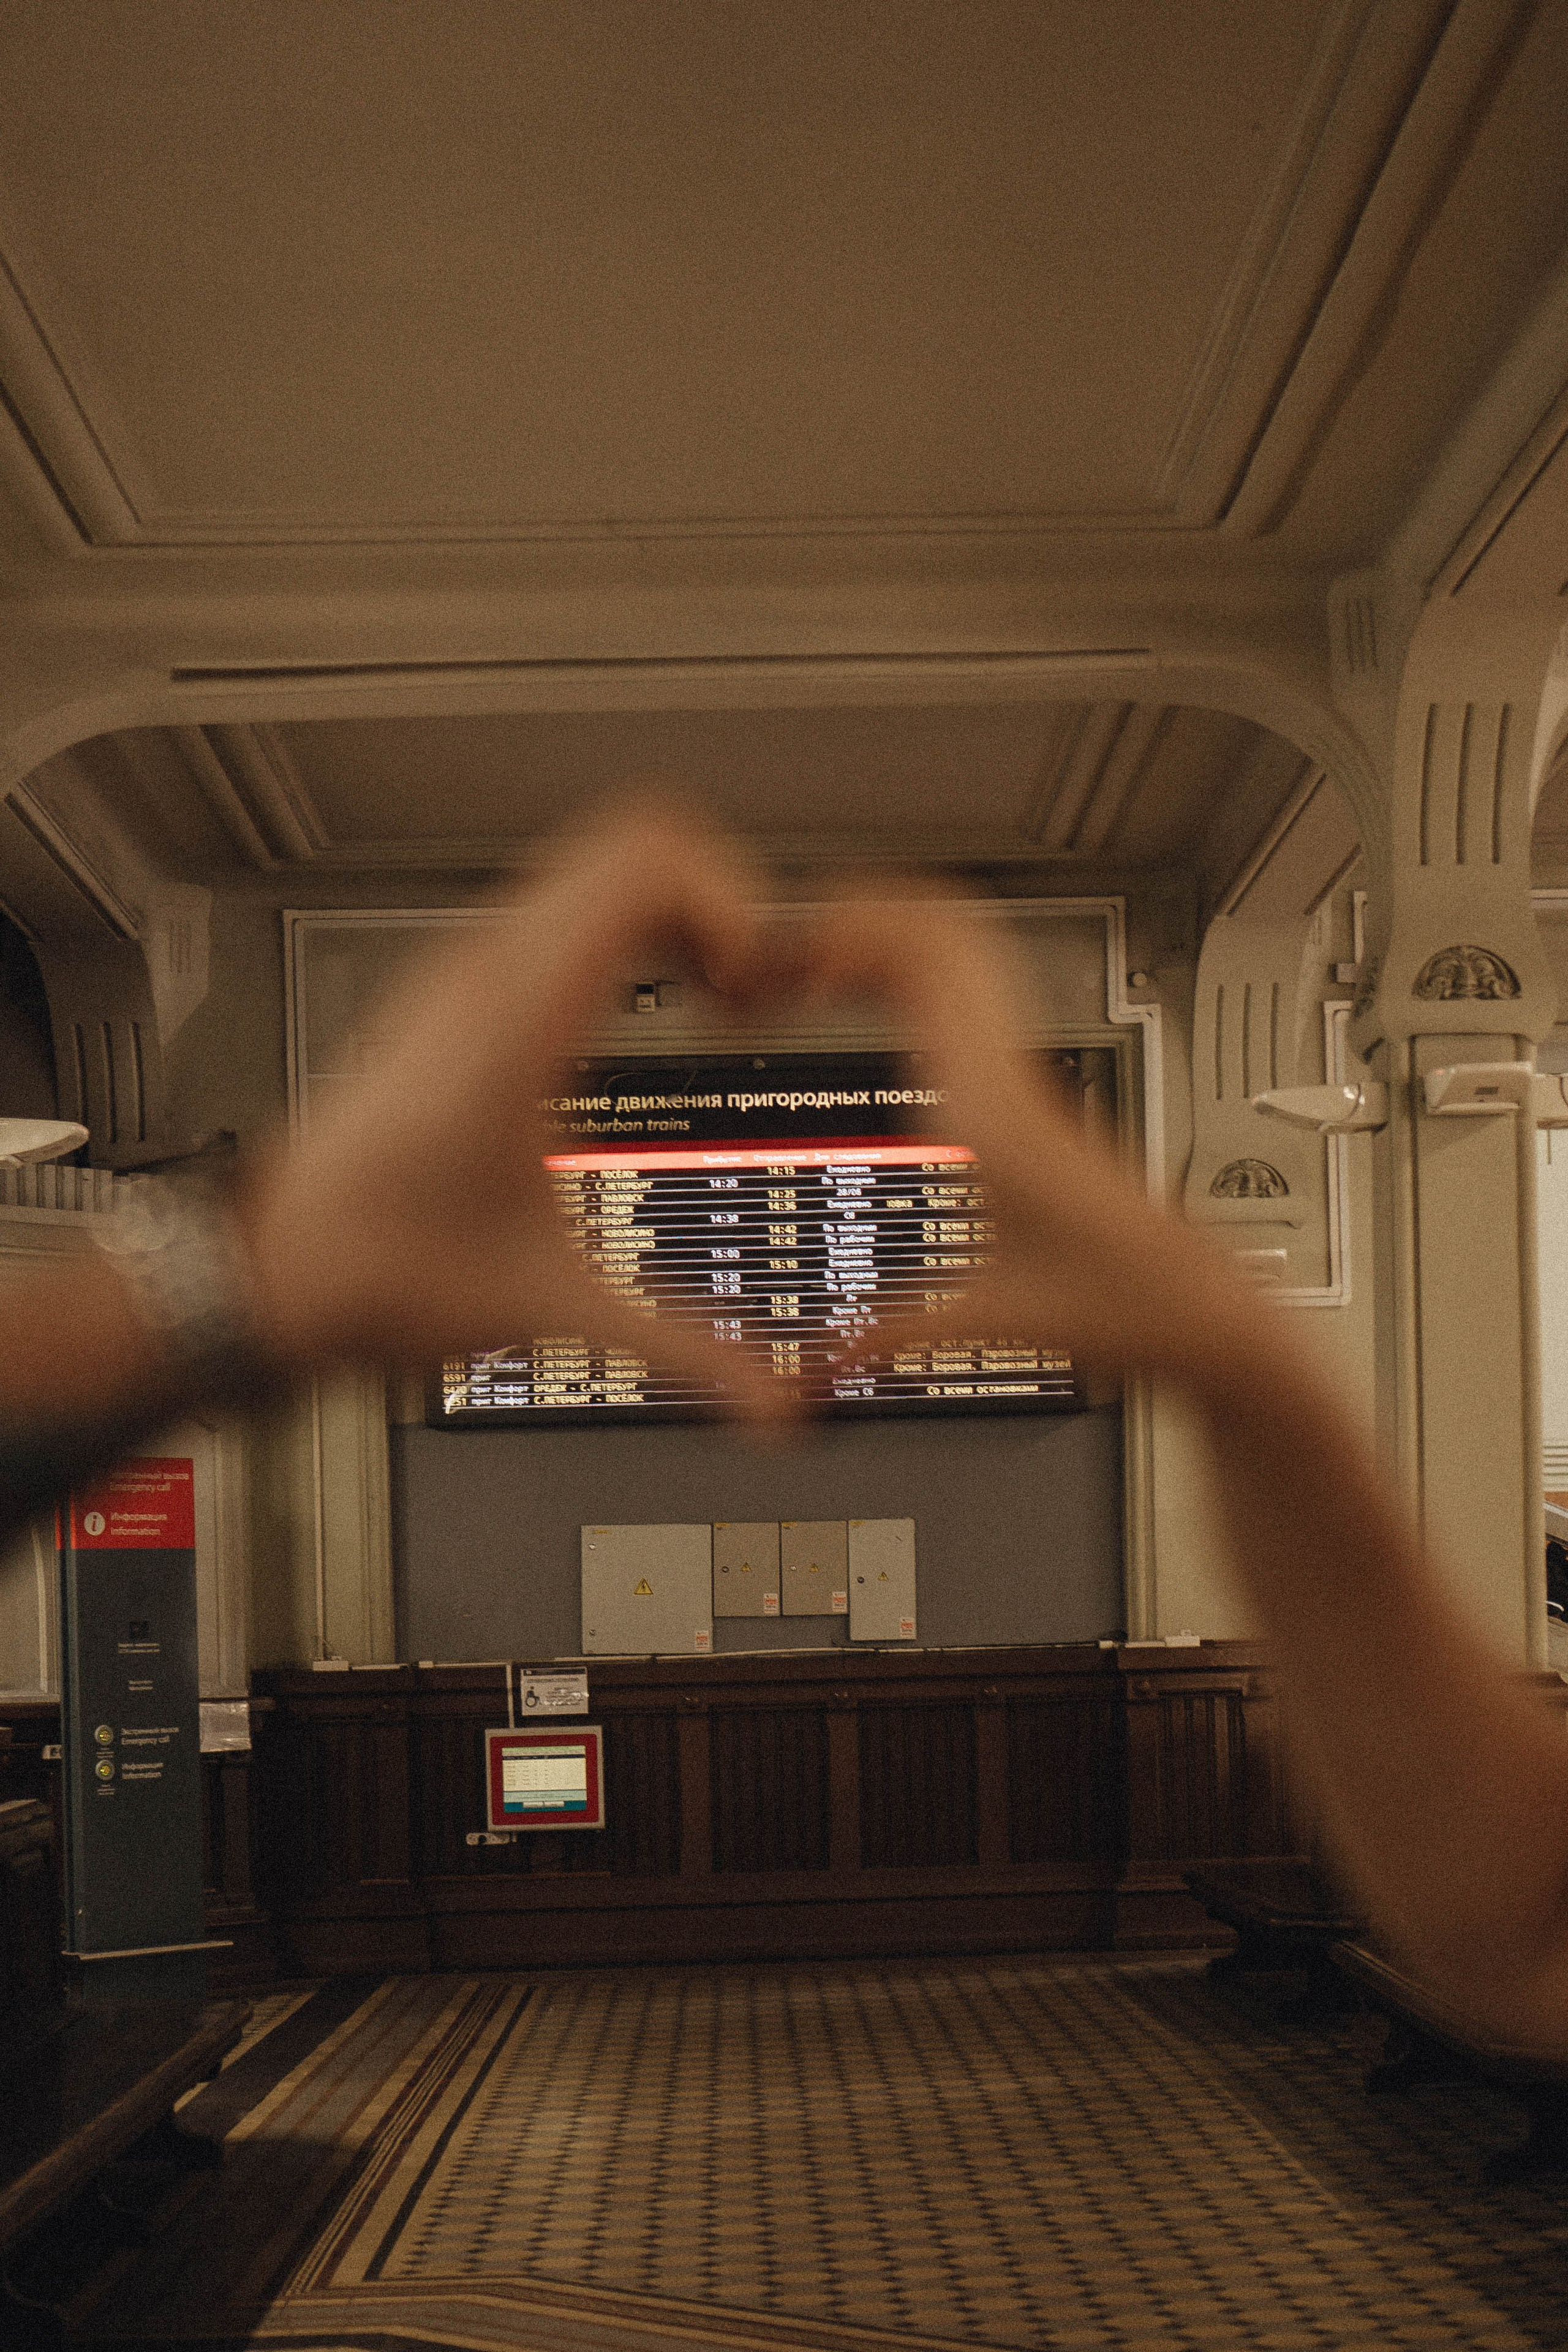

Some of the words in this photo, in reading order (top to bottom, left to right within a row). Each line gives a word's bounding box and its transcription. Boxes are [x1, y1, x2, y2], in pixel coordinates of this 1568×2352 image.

[615, 1095, 722, 1112] движения
[727, 1090, 870, 1112] пригородных
[569, 1119, 643, 1133] suburban
[647, 1118, 690, 1131] trains
[767, 1166, 796, 1175] 14:15
[922, 1163, 934, 1171] Со
[709, 1179, 738, 1188] 14:20
[768, 1190, 796, 1199] 14:25
[768, 1202, 797, 1210] 14:36
[710, 1215, 739, 1223] 14:38
[769, 1225, 797, 1234] 14:42
[922, 1222, 935, 1231] Со
[769, 1237, 797, 1245] 14:42
[826, 1235, 837, 1244] По
[922, 1233, 936, 1242] Со
[711, 1250, 740, 1258] 15:00
[769, 1260, 798, 1269] 15:10
[924, 1256, 937, 1266] Со
[712, 1273, 741, 1282] 15:20
[712, 1285, 741, 1294] 15:20
[771, 1295, 799, 1305] 15:38
[713, 1321, 741, 1329] 15:43
[714, 1332, 742, 1341] 15:43
[772, 1343, 800, 1351] 15:47
[772, 1354, 801, 1364] 16:00
[533, 1360, 590, 1369] С.ПЕТЕРБУРГ
[773, 1366, 801, 1375] 16:00
[533, 1372, 590, 1381] С.ПЕТЕРБУРГ
[605, 1370, 648, 1379] ПАВЛОВСК
[494, 1385, 529, 1393] Комфорт
[580, 1382, 638, 1392] С.ПЕТЕРБУРГ
[927, 1386, 940, 1395] Со
[944, 1386, 973, 1395] всеми
[976, 1385, 1038, 1393] остановками
[494, 1396, 530, 1406] Комфорт
[534, 1395, 592, 1404] С.ПЕТЕРБУРГ
